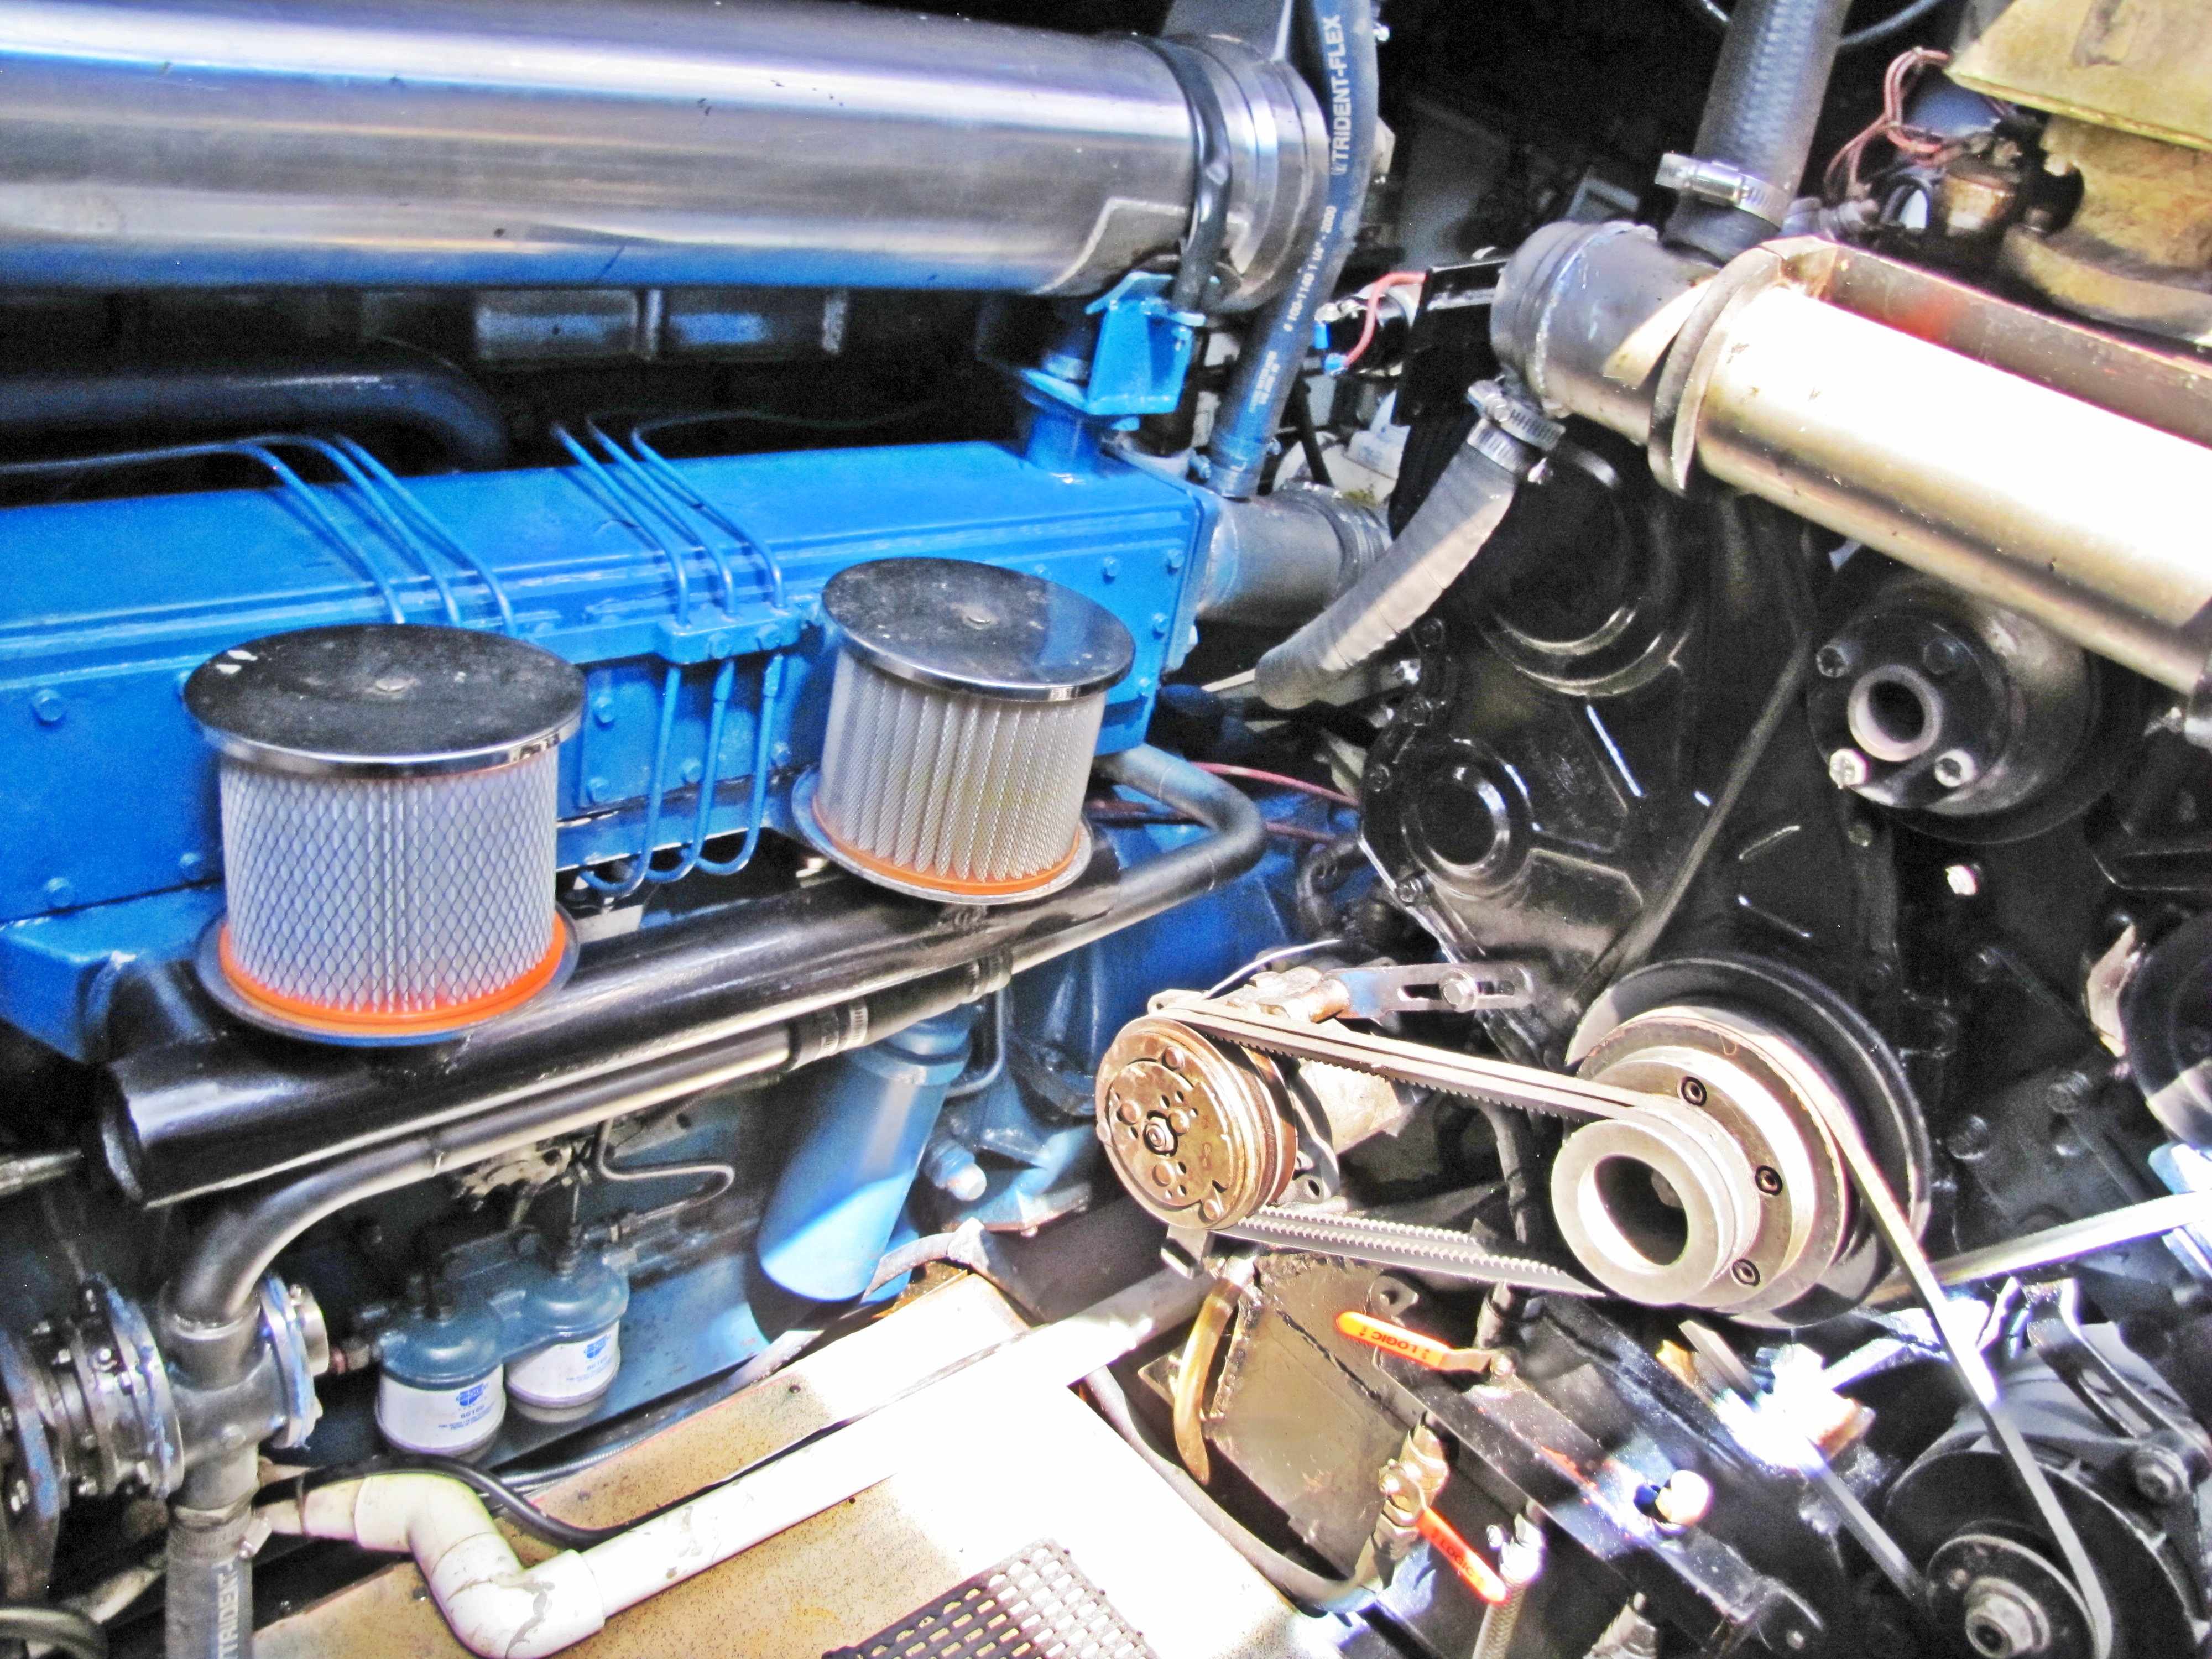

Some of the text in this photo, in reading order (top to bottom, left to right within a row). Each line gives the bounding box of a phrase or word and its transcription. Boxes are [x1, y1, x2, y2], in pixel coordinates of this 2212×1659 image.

[1322, 14, 1352, 163] TRIDENT-FLEX
[1371, 1331, 1418, 1354] LOGIC
[1439, 1538, 1475, 1577] LOGIC
